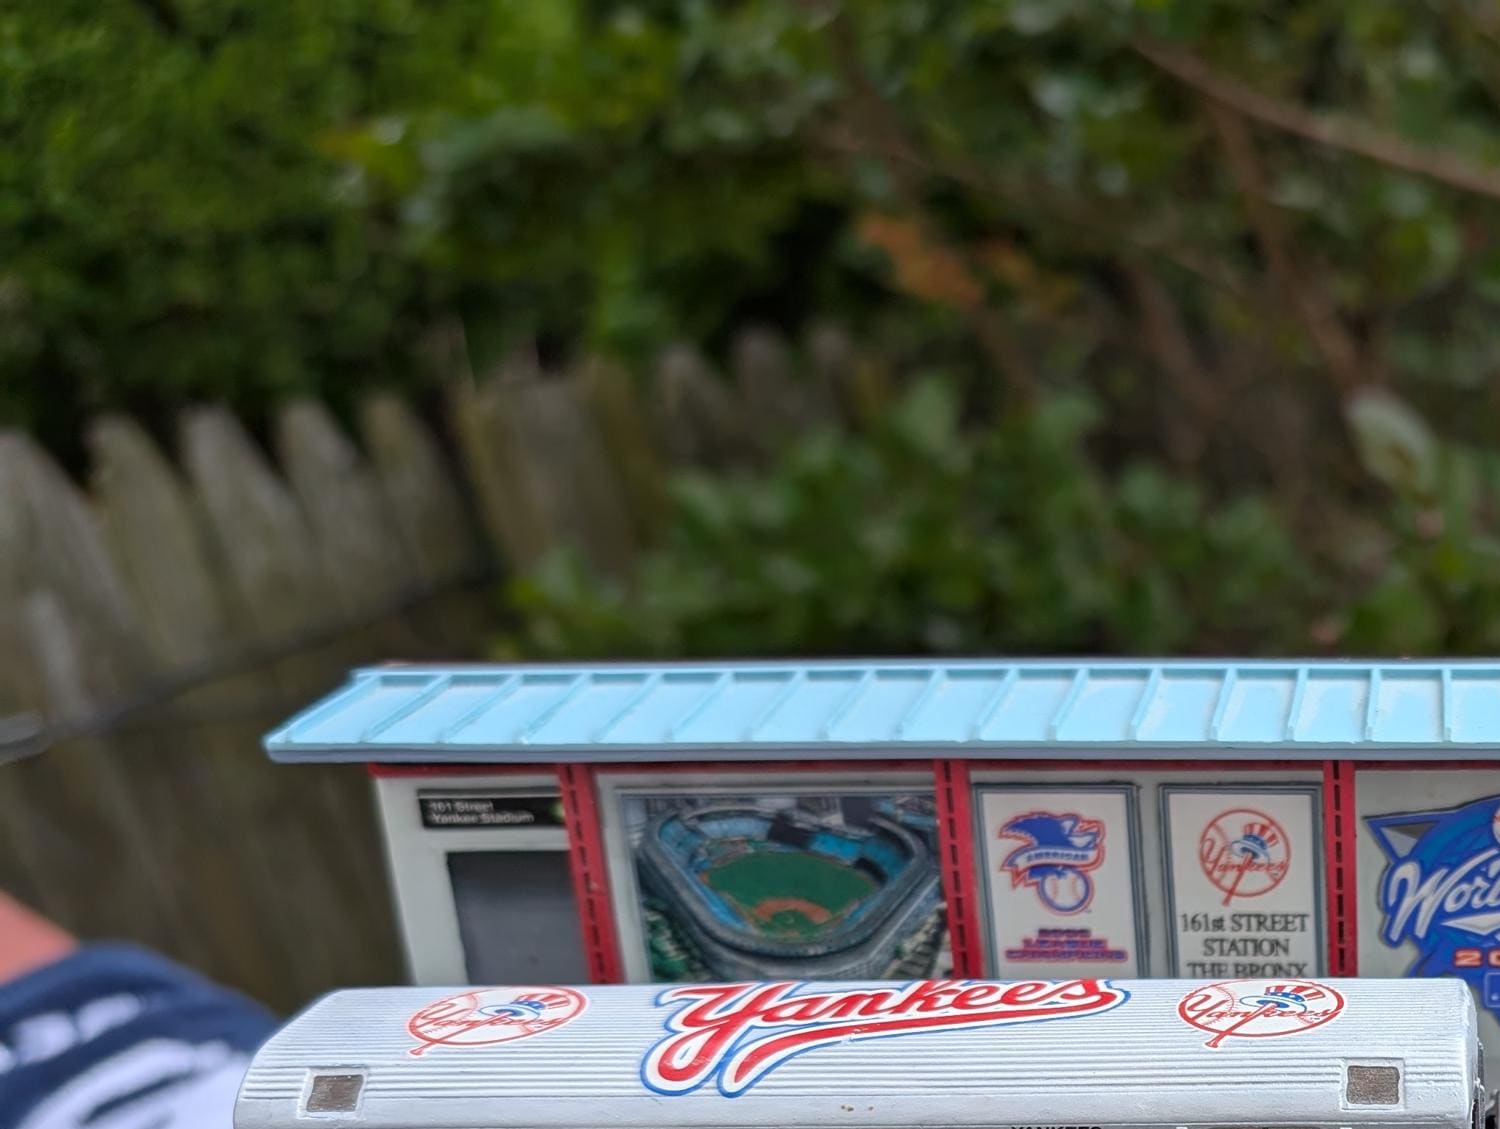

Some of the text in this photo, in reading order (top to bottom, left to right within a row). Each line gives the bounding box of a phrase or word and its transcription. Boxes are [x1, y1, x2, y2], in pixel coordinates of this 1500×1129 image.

[481, 812, 534, 823] Stadium
[1181, 914, 1309, 932] 161st STREET
[1203, 939, 1290, 956] STATION
[636, 978, 1131, 1097] Yankees
